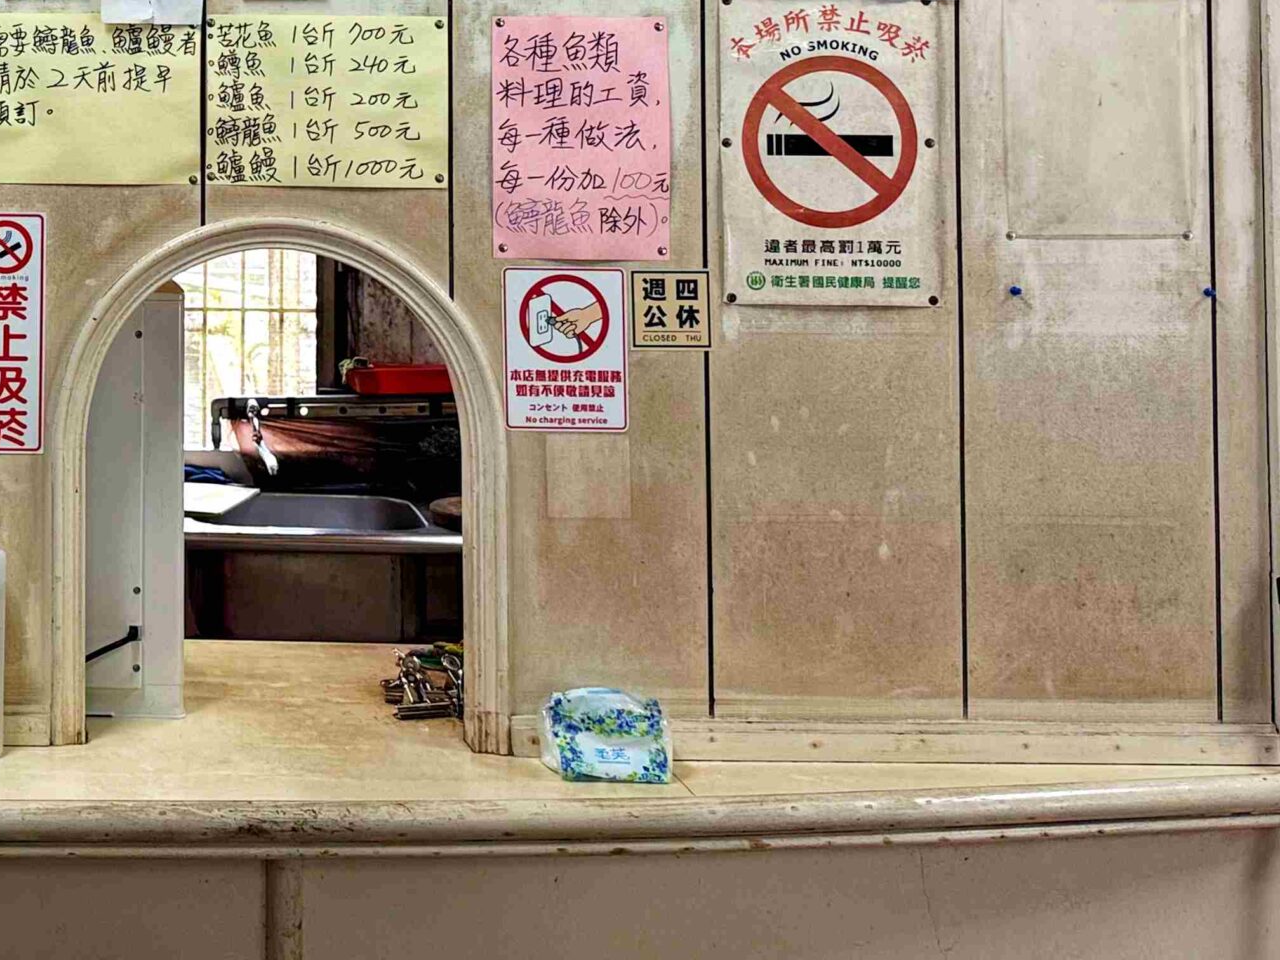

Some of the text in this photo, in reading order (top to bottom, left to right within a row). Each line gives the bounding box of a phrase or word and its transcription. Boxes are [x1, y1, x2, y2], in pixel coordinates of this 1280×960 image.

[780, 40, 880, 62] NO SMOKING
[765, 259, 808, 267] MAXIMUM
[642, 278, 698, 301] 週四
[643, 305, 700, 329] 公休
